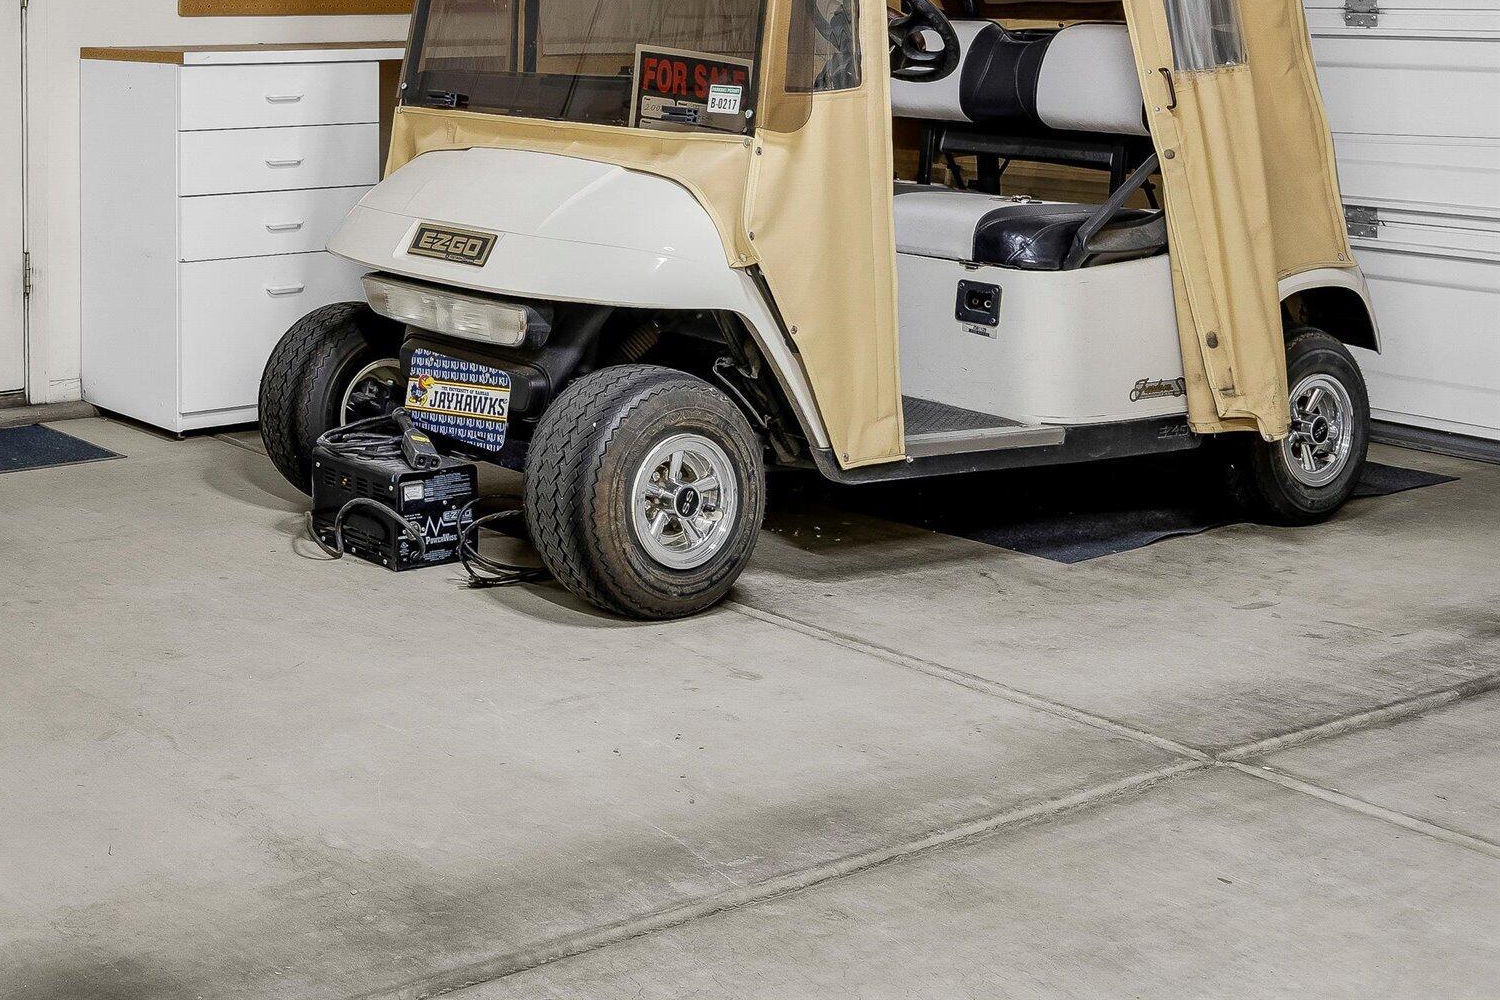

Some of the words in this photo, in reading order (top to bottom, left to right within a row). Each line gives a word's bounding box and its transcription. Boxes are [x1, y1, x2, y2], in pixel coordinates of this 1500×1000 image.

[642, 57, 688, 96] FOR
[710, 97, 738, 110] B-0217
[418, 231, 483, 257] EZGO
[429, 390, 505, 416] JAYHAWKS
